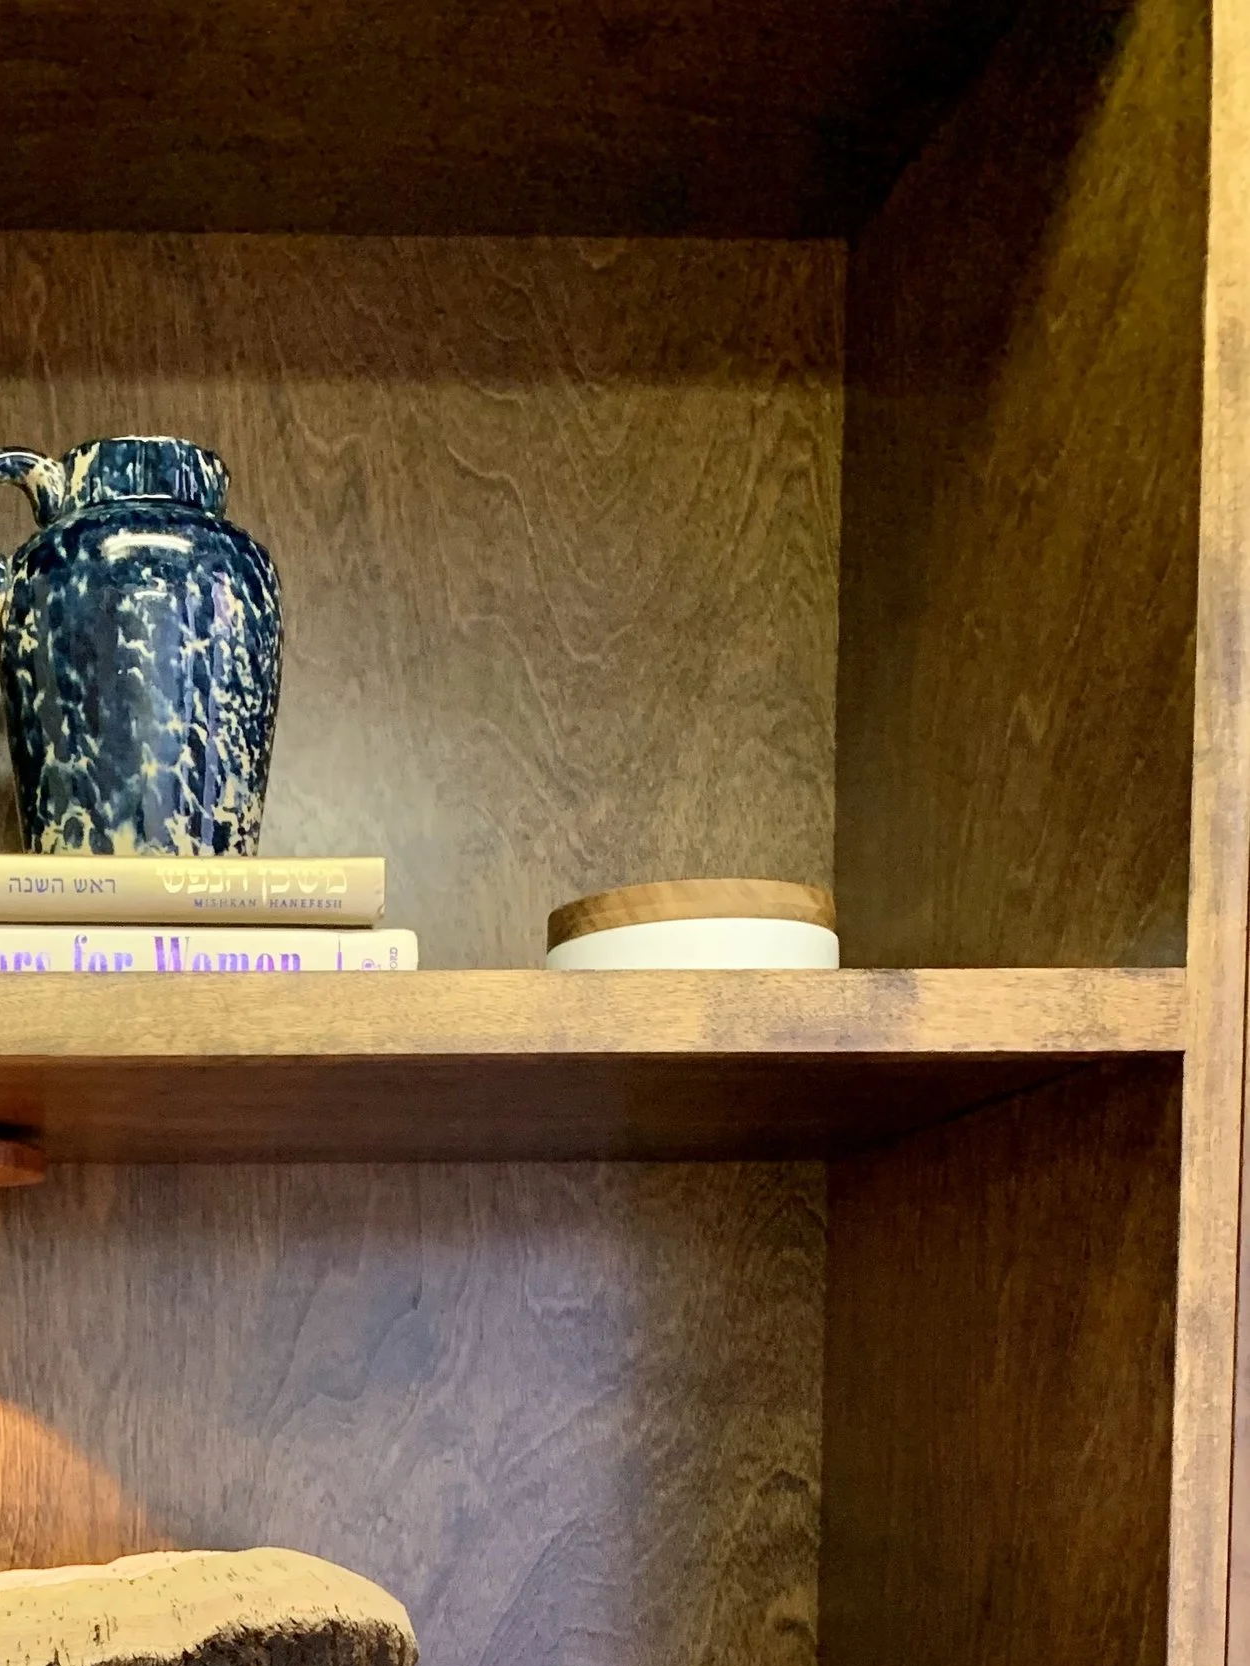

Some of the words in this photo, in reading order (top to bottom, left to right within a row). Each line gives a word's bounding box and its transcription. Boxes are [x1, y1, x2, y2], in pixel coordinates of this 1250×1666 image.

[9, 877, 65, 894] השנה
[74, 878, 116, 894] ראש
[258, 867, 347, 906] משכן
[194, 899, 256, 909] MISHKAN
[270, 899, 342, 909] HANEFESH
